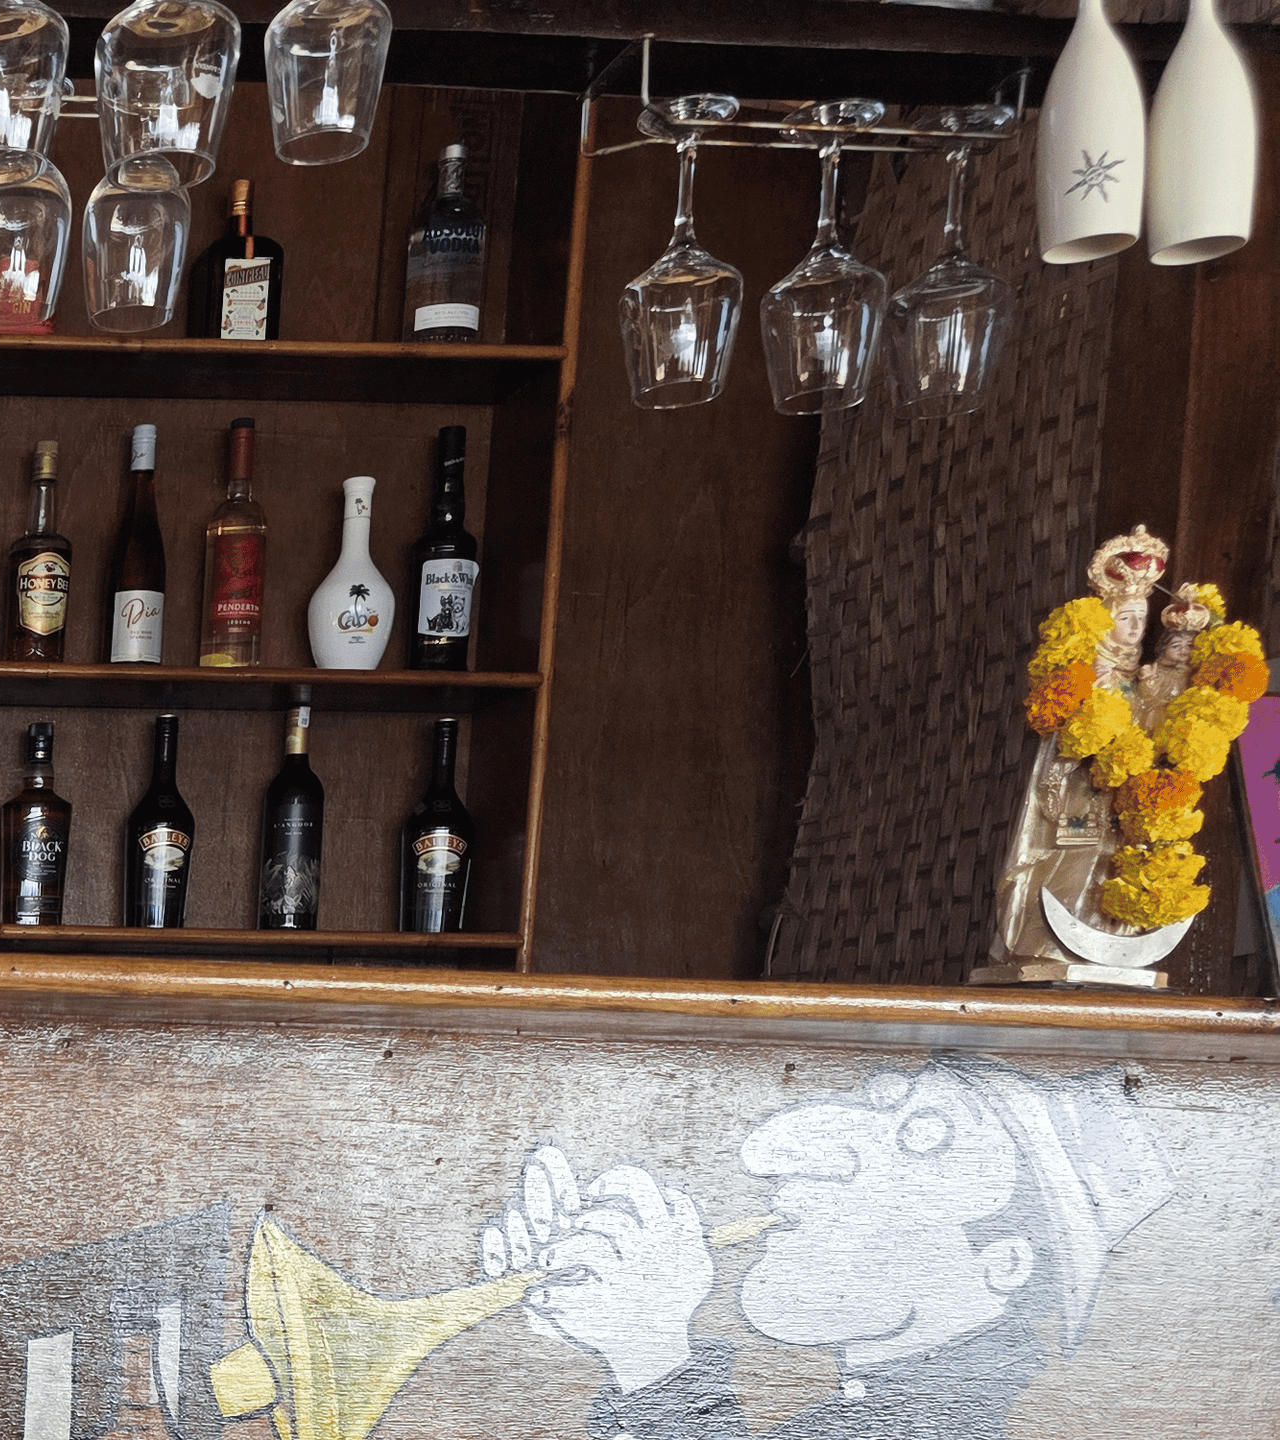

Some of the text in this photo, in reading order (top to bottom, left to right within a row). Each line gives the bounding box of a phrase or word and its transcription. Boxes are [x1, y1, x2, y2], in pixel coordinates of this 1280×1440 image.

[13, 302, 31, 314] GIN
[20, 577, 69, 591] HONEY BEE
[121, 597, 161, 629] Dia
[22, 841, 62, 852] BLACK
[142, 832, 189, 847] BAILEYS
[415, 837, 465, 851] BAILEYS
[29, 851, 56, 862] DOG
